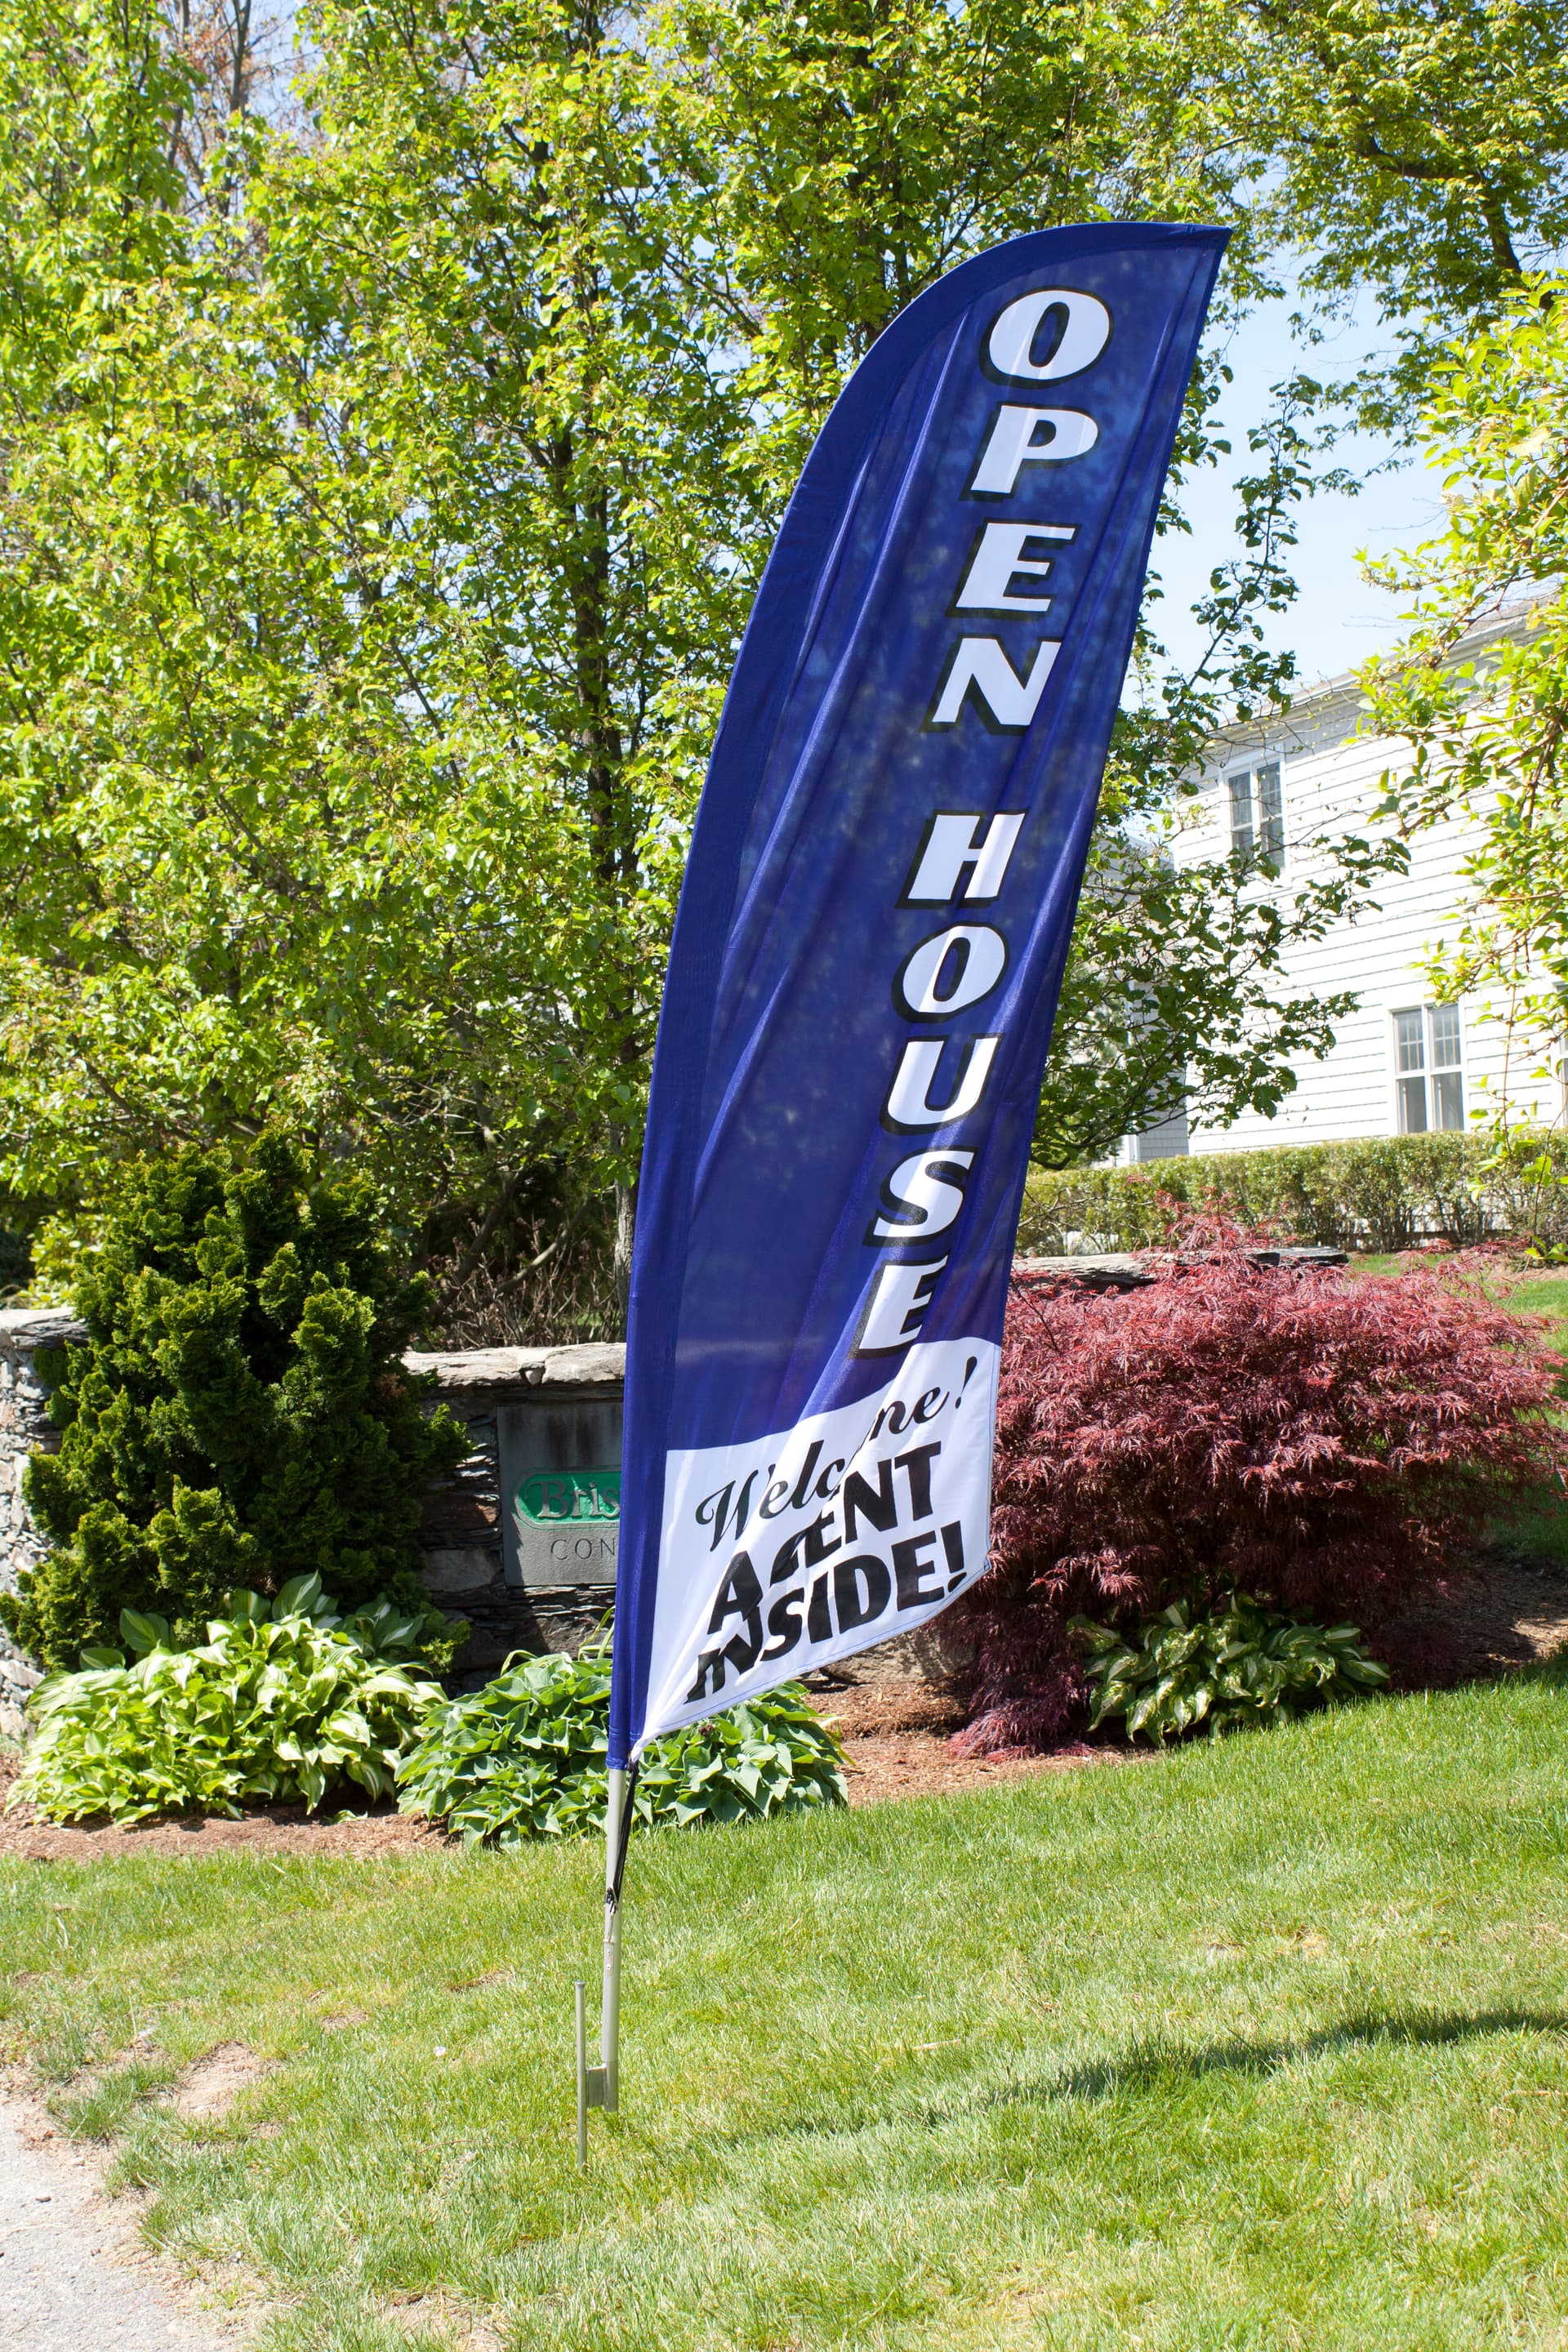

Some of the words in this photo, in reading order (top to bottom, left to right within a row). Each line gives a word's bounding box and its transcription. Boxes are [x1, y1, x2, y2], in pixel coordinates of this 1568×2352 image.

[919, 286, 1114, 735] OPEN
[848, 808, 1028, 1359] HOUSE
[696, 1356, 978, 1552] Welcme!
